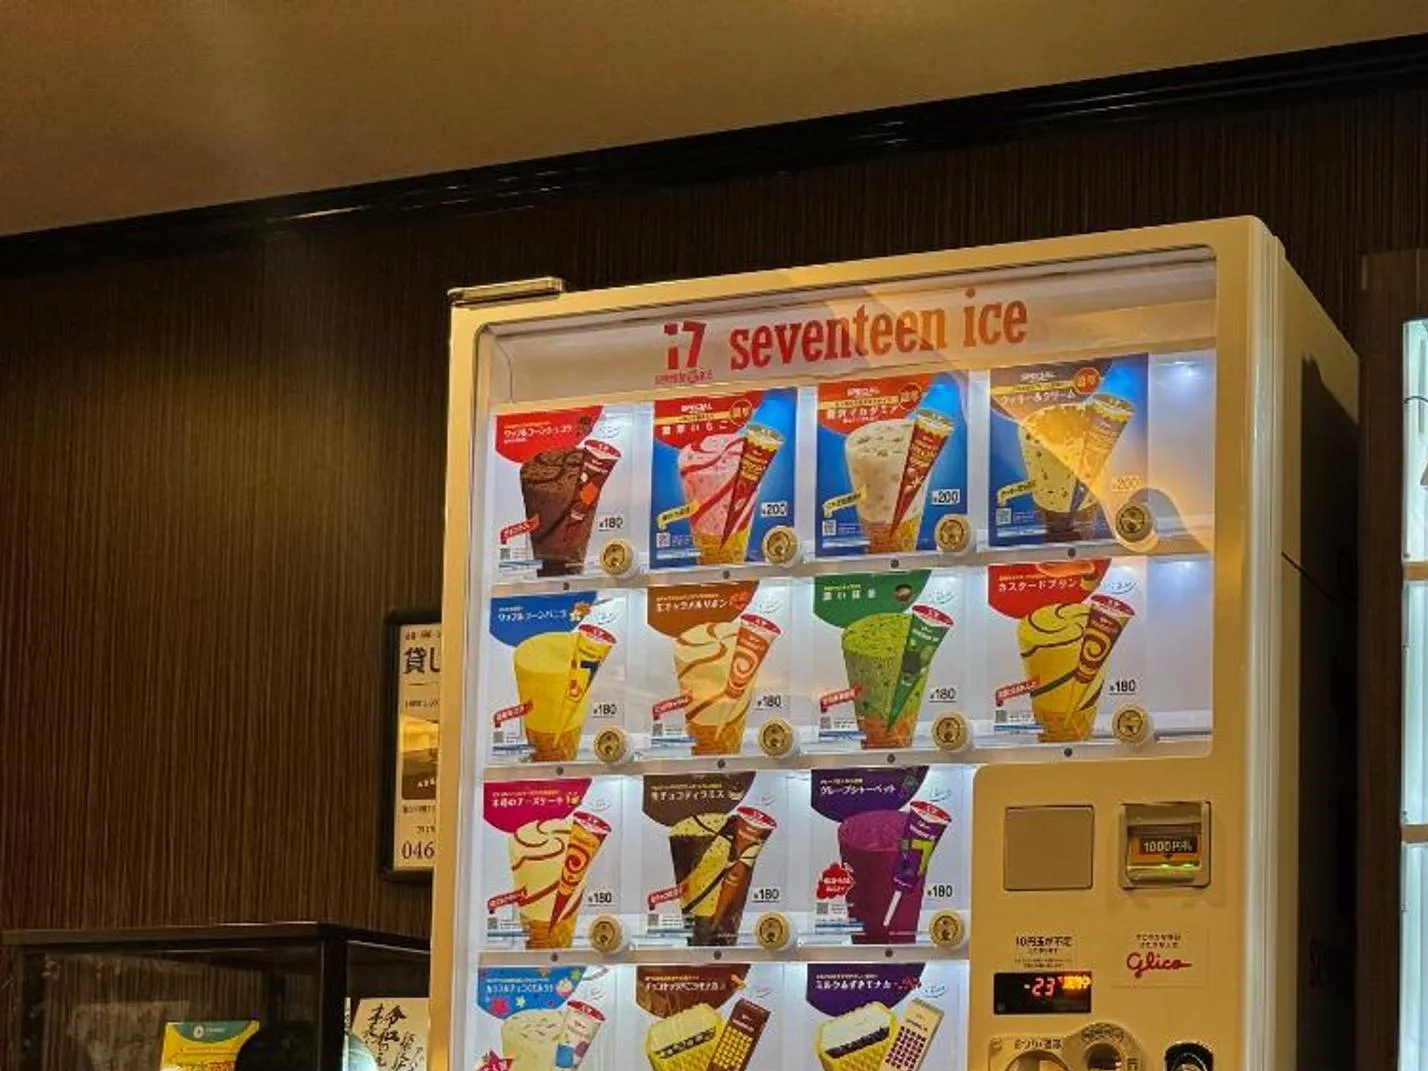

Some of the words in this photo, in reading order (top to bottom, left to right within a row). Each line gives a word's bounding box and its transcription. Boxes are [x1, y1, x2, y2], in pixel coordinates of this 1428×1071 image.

[730, 304, 946, 371] seventeen
[962, 288, 1028, 348] ice
[401, 841, 435, 860] 046
[1126, 952, 1193, 979] Glico
